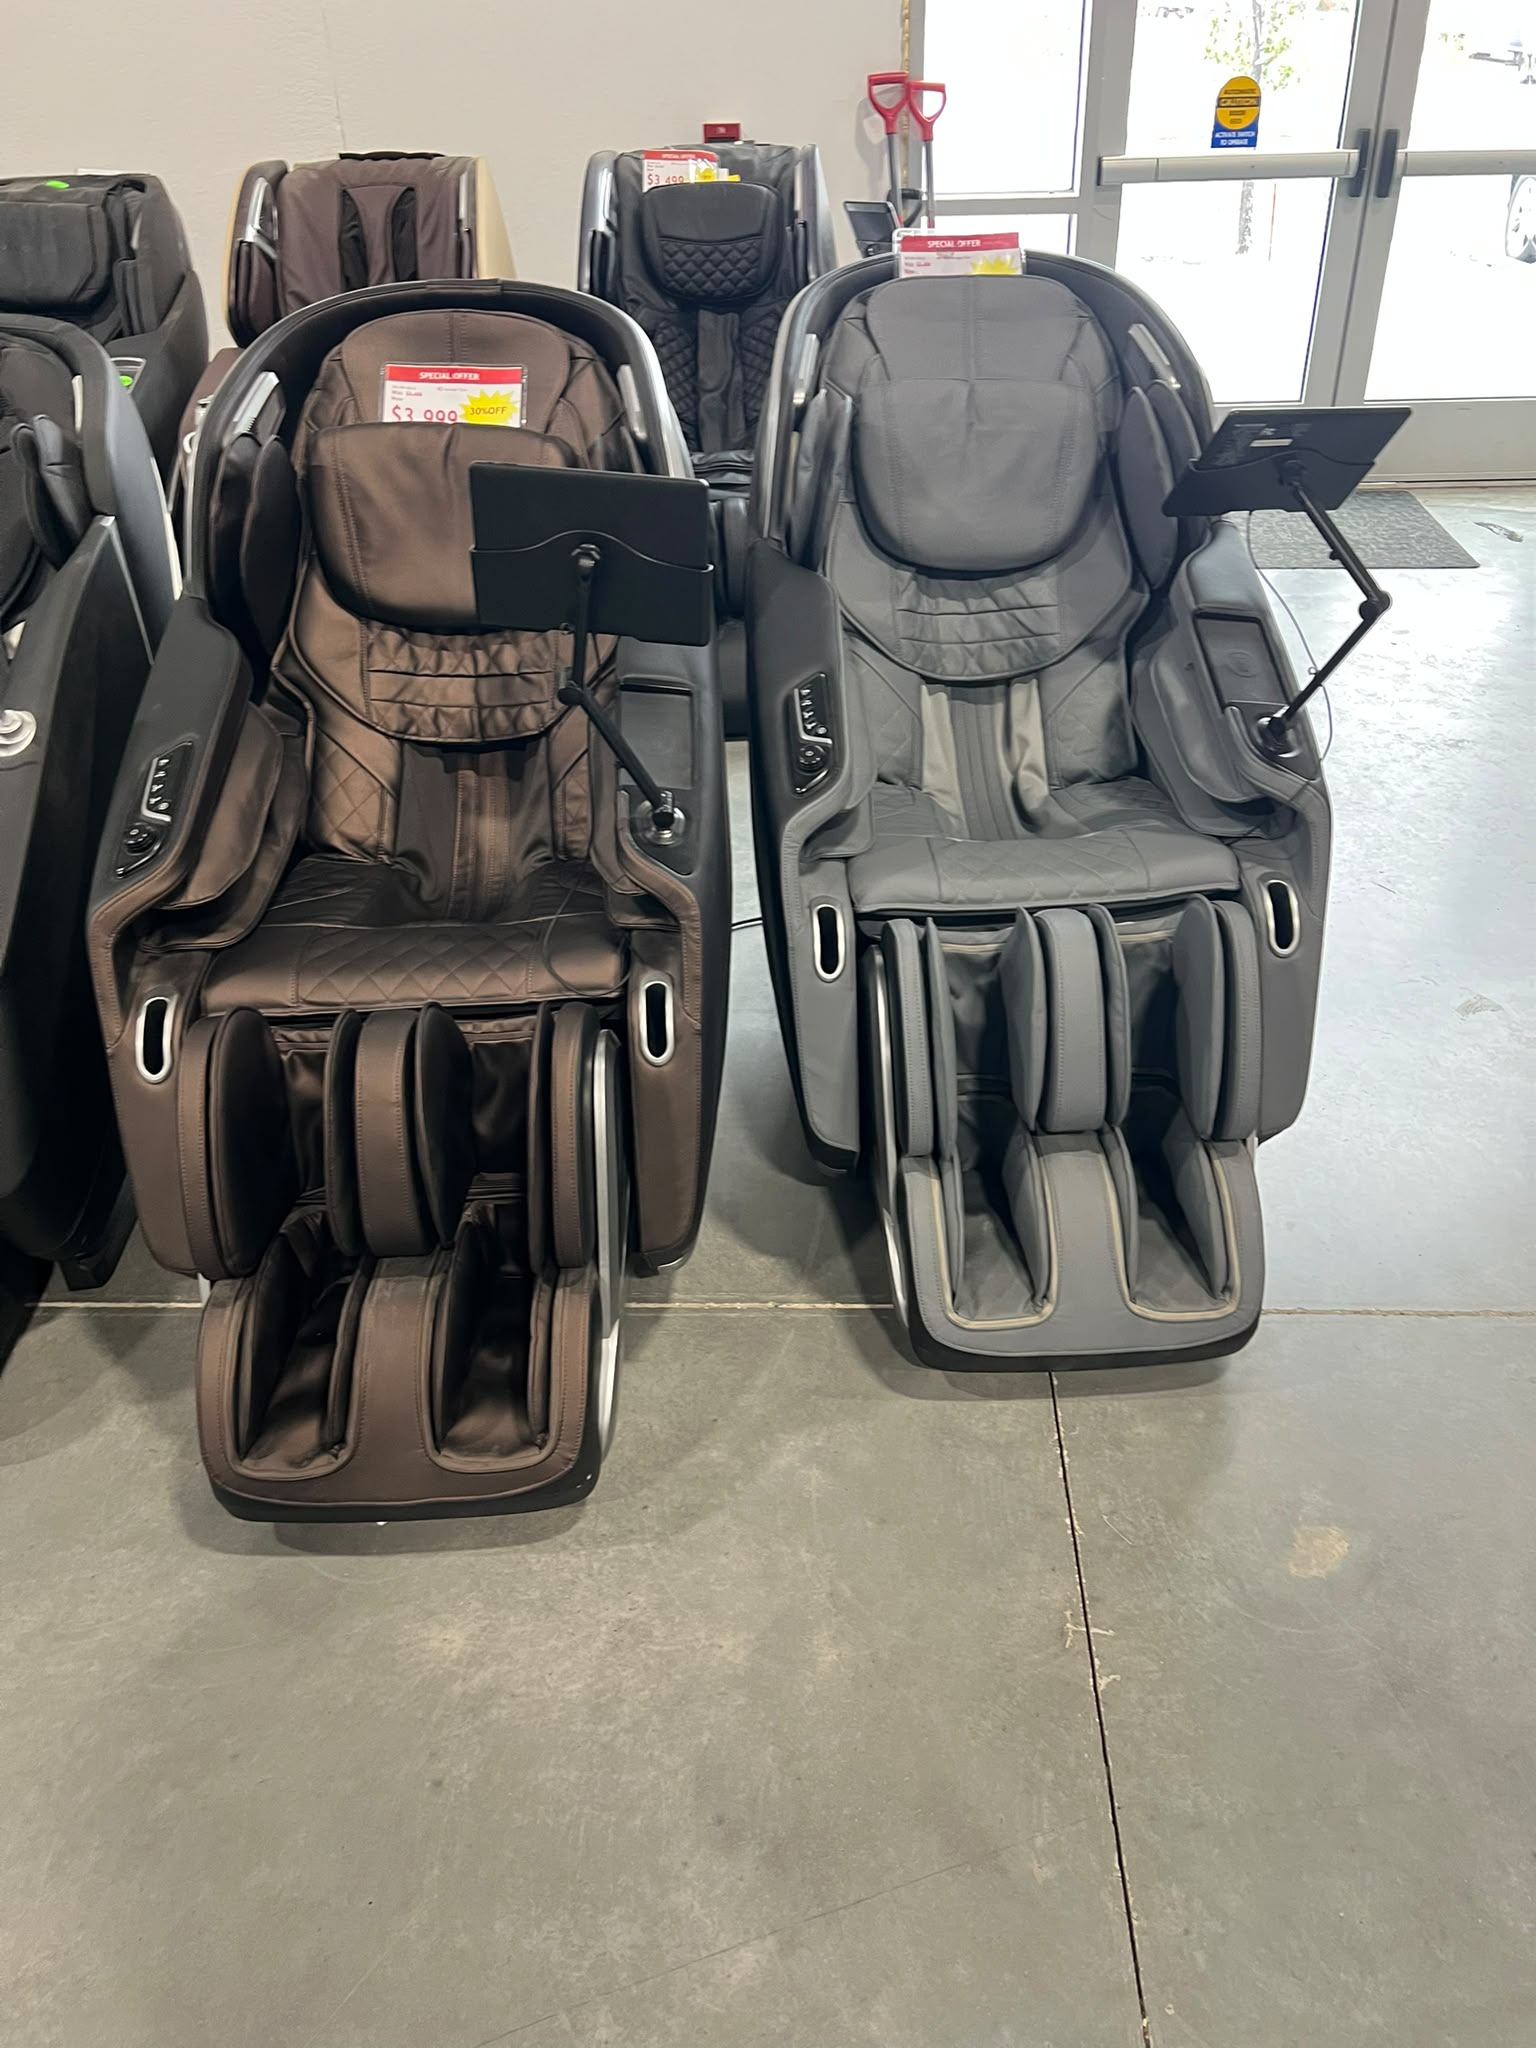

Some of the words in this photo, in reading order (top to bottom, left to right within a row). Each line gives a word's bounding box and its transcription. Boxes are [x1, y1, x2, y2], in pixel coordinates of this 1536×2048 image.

[927, 240, 955, 248] SPECIAL
[957, 239, 981, 248] OFFER
[418, 371, 451, 380] SPECIAL
[451, 372, 481, 381] OFFER
